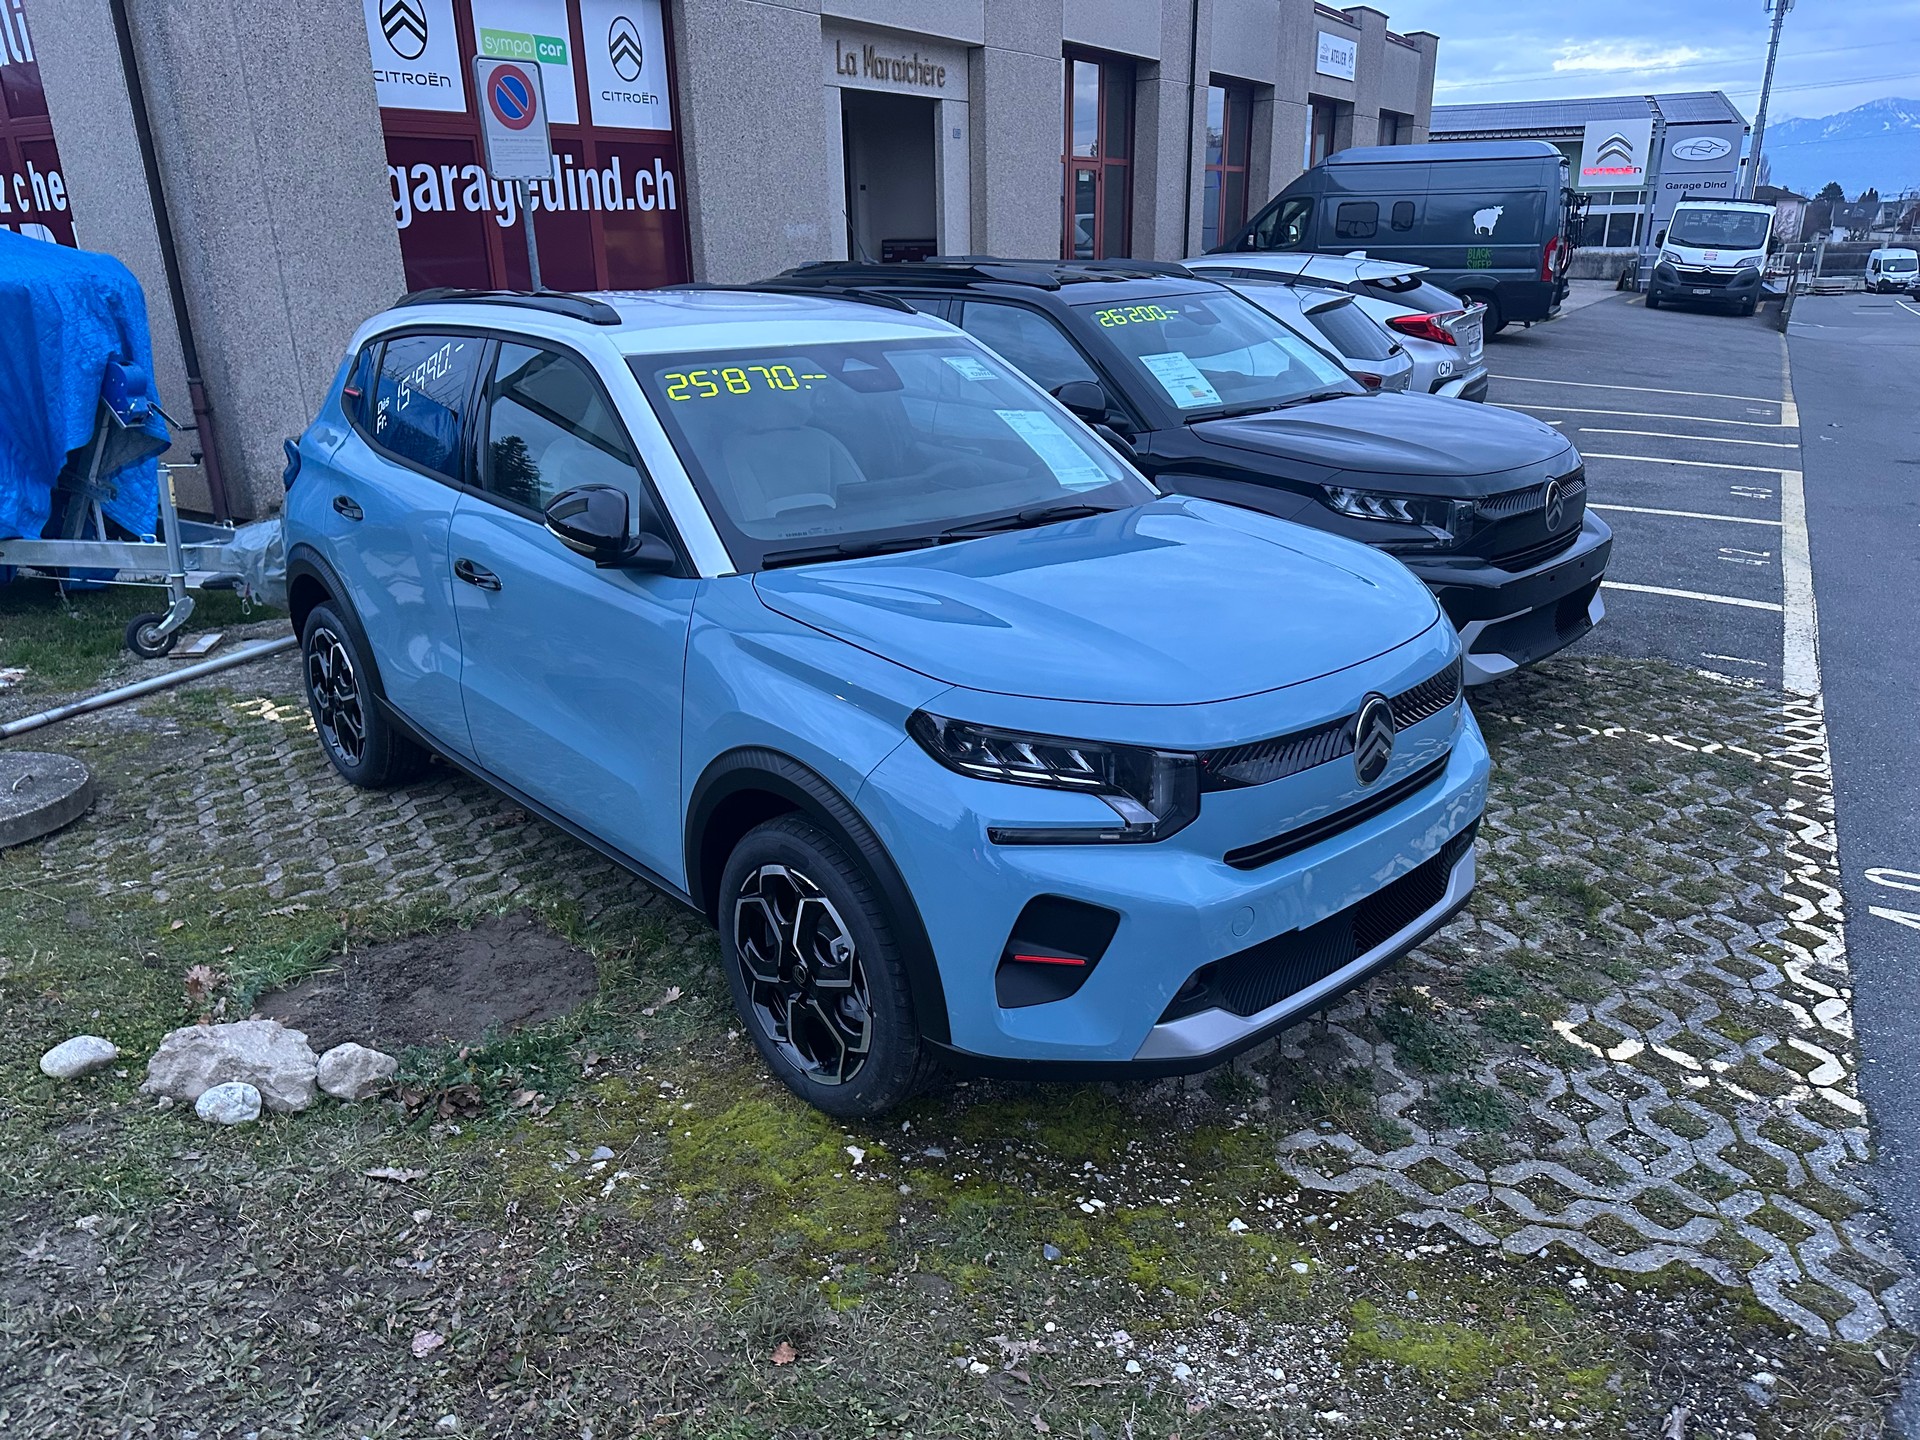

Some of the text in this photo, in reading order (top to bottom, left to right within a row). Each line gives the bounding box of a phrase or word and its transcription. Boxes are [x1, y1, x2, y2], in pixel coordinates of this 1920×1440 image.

[484, 36, 563, 57] sympa car
[836, 40, 858, 76] La
[1330, 48, 1347, 66] ATELIER
[1665, 181, 1728, 191] Garage Dind
[1467, 247, 1492, 260] BLACK
[1440, 362, 1451, 376] CH
[376, 414, 388, 435] Fr.
